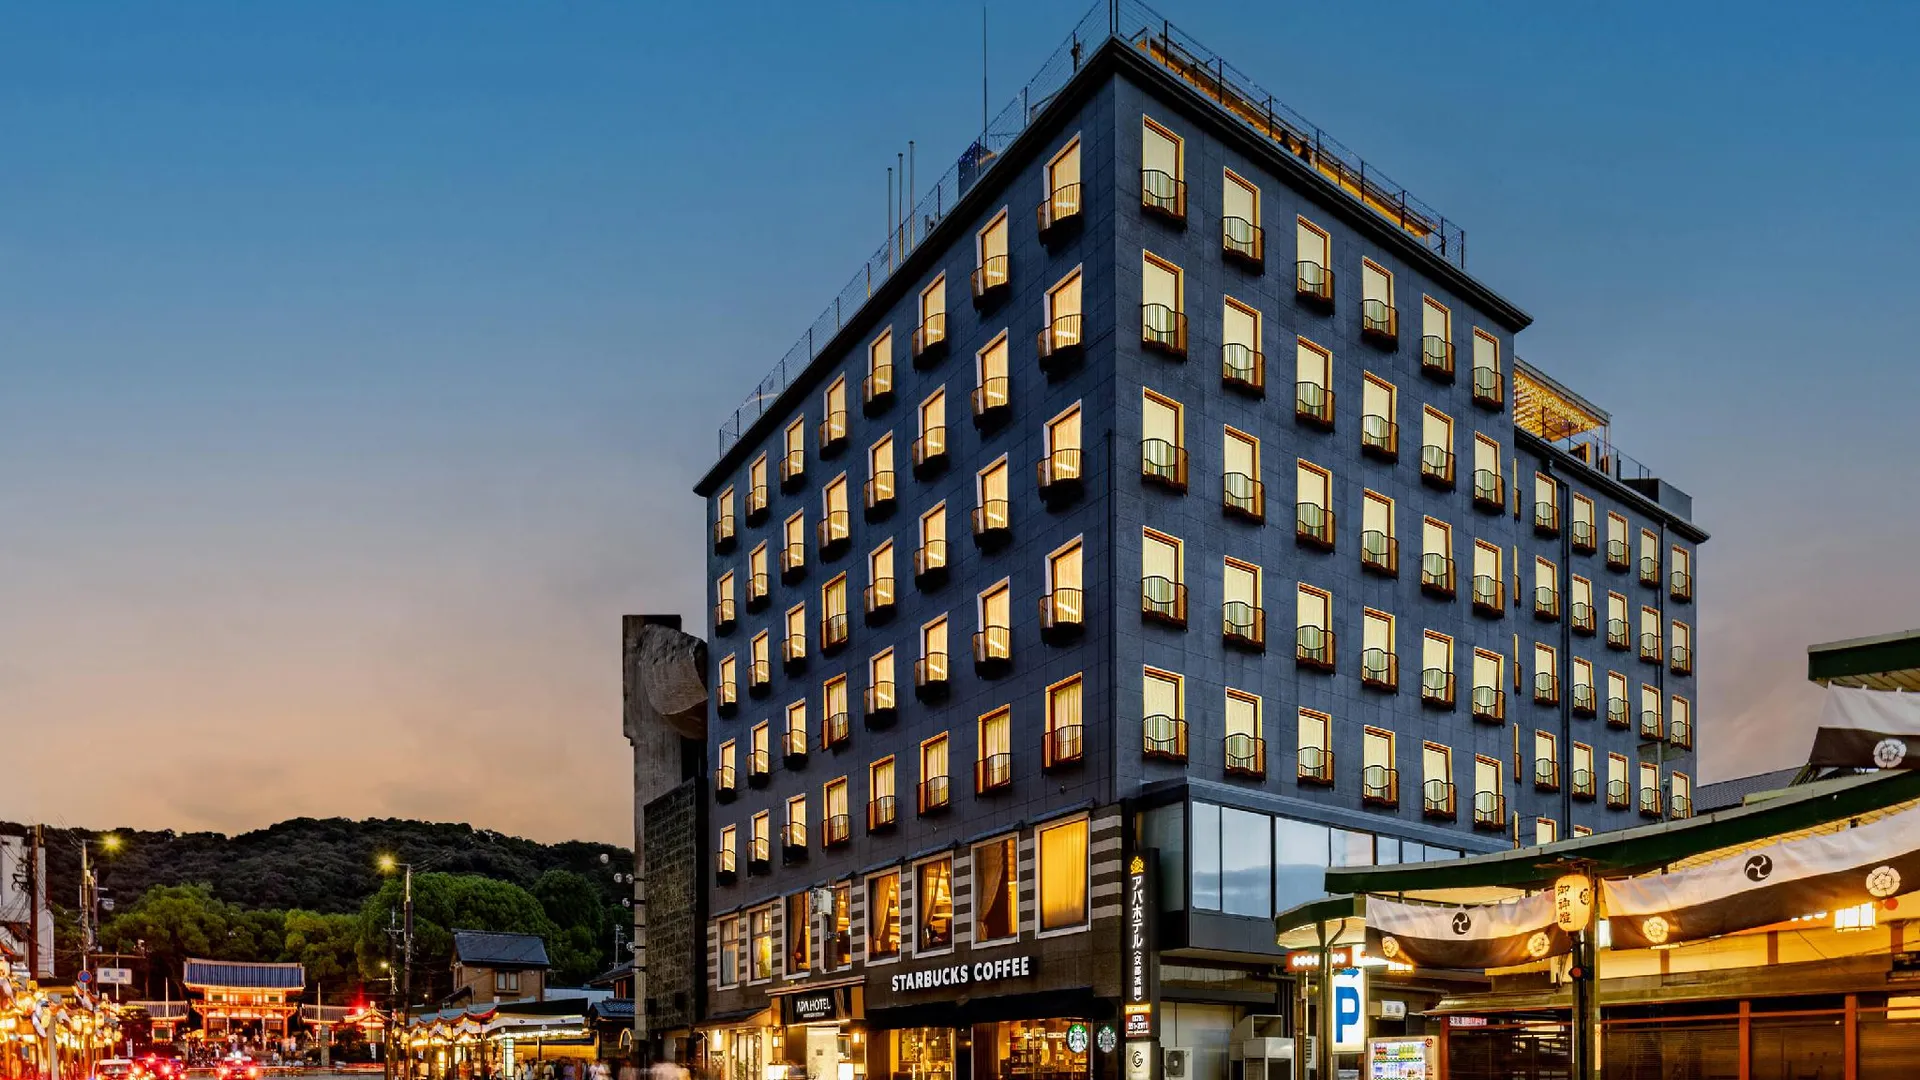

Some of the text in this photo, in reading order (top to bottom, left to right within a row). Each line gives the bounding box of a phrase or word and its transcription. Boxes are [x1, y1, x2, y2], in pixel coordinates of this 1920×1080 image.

[891, 956, 1030, 992] STARBUCKS COFFEE
[796, 998, 831, 1013] APA HOTEL
[1335, 986, 1360, 1043] P
